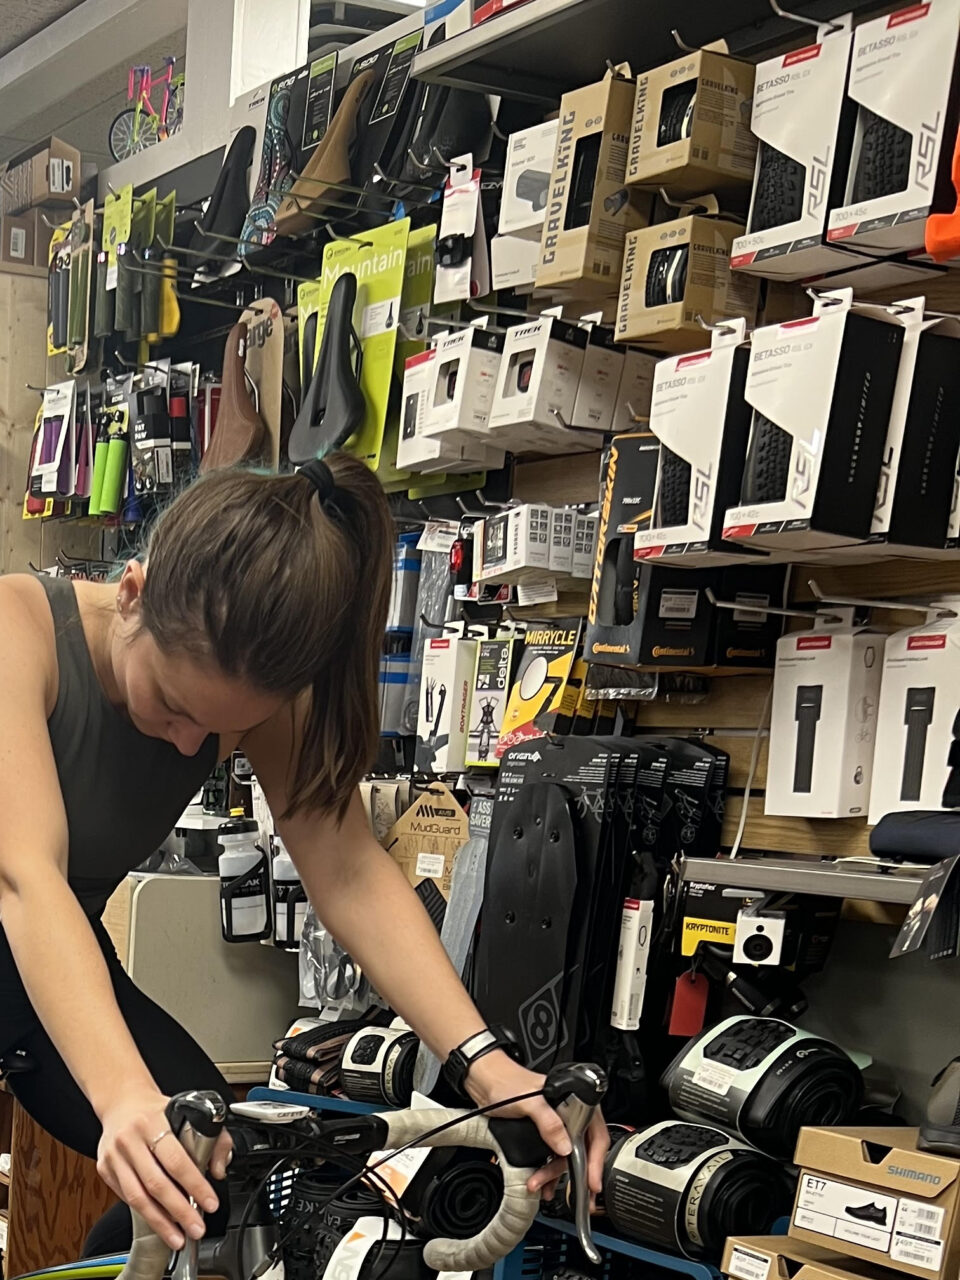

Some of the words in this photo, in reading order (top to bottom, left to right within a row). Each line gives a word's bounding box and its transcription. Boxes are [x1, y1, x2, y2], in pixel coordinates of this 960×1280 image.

[857, 35, 896, 58] BETASSO
[756, 73, 790, 95] BETASSO
[629, 76, 649, 177] GRAVELKING
[914, 110, 941, 192] RSL
[542, 110, 576, 265] GRAVELKING
[806, 145, 831, 220] RSL
[618, 236, 638, 334] GRAVELKING
[512, 324, 543, 338] TREK
[754, 344, 791, 363] BETASSO
[692, 461, 713, 532] RSL
[524, 629, 577, 646] MIRRYCLE
[496, 648, 509, 689] delta
[460, 680, 469, 733] BONTRAGER
[477, 801, 491, 815] ASS
[410, 822, 461, 835] MudGuard
[469, 814, 492, 829] SAVER
[685, 921, 731, 936] KRYPTONITE
[276, 1111, 304, 1119] CATEYE
[806, 1178, 827, 1193] ET7
[887, 1165, 941, 1186] SHIMANO
[687, 1151, 730, 1228] TERAVAIL
